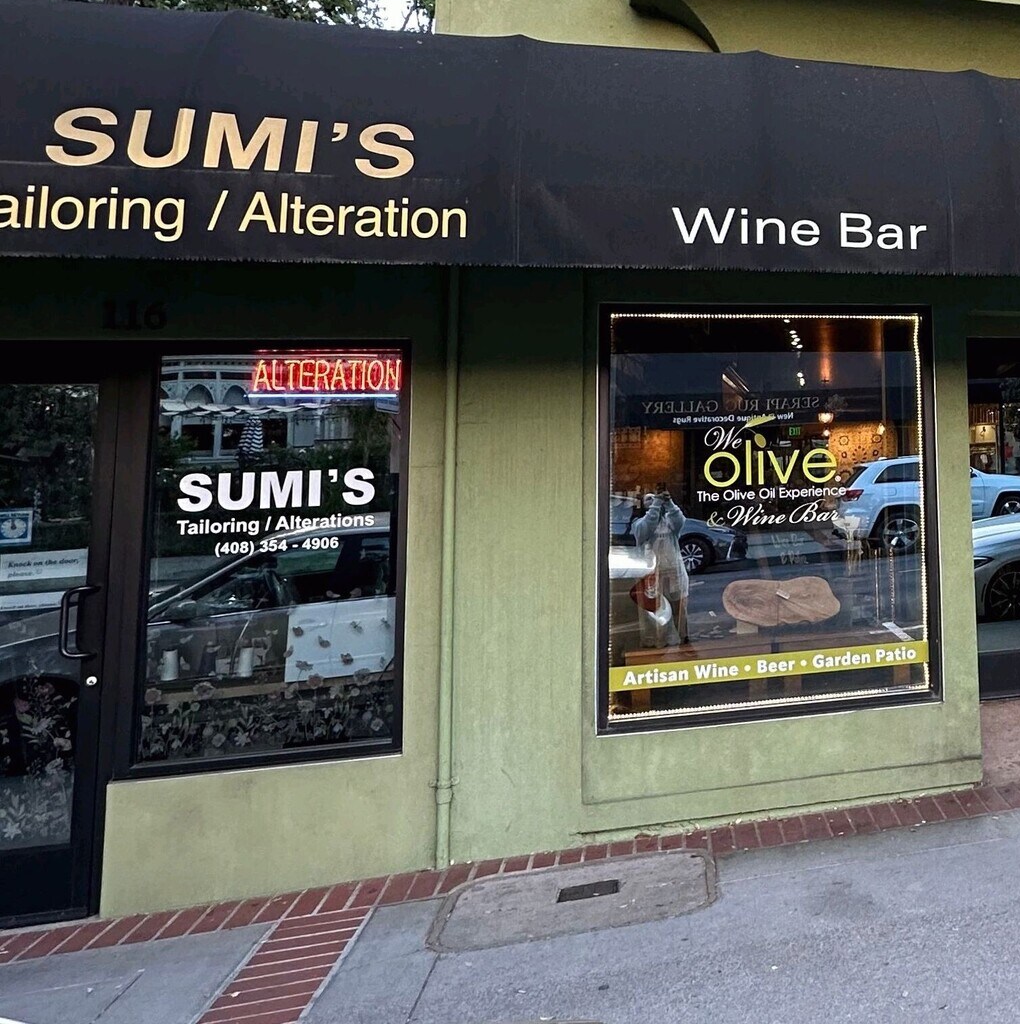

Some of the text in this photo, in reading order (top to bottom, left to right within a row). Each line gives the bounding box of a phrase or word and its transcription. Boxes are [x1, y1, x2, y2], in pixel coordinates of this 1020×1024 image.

[44, 107, 416, 179] SUMI'S
[0, 184, 187, 243] ailoring
[238, 189, 469, 240] Alteration
[671, 206, 928, 250] Wine Bar
[252, 358, 403, 393] ALTERATION
[703, 425, 743, 451] We
[176, 467, 376, 513] SUMI'S
[696, 484, 848, 503] The Olive Oil Experience
[176, 518, 260, 537] Tailoring
[276, 513, 376, 532] Alterations
[726, 505, 788, 527] Wine
[788, 498, 841, 524] Bar
[213, 539, 256, 558] (408)
[259, 538, 288, 554] 354
[302, 536, 340, 552] 4906
[622, 647, 917, 686] Artisan Wine Beer Garden Patio
